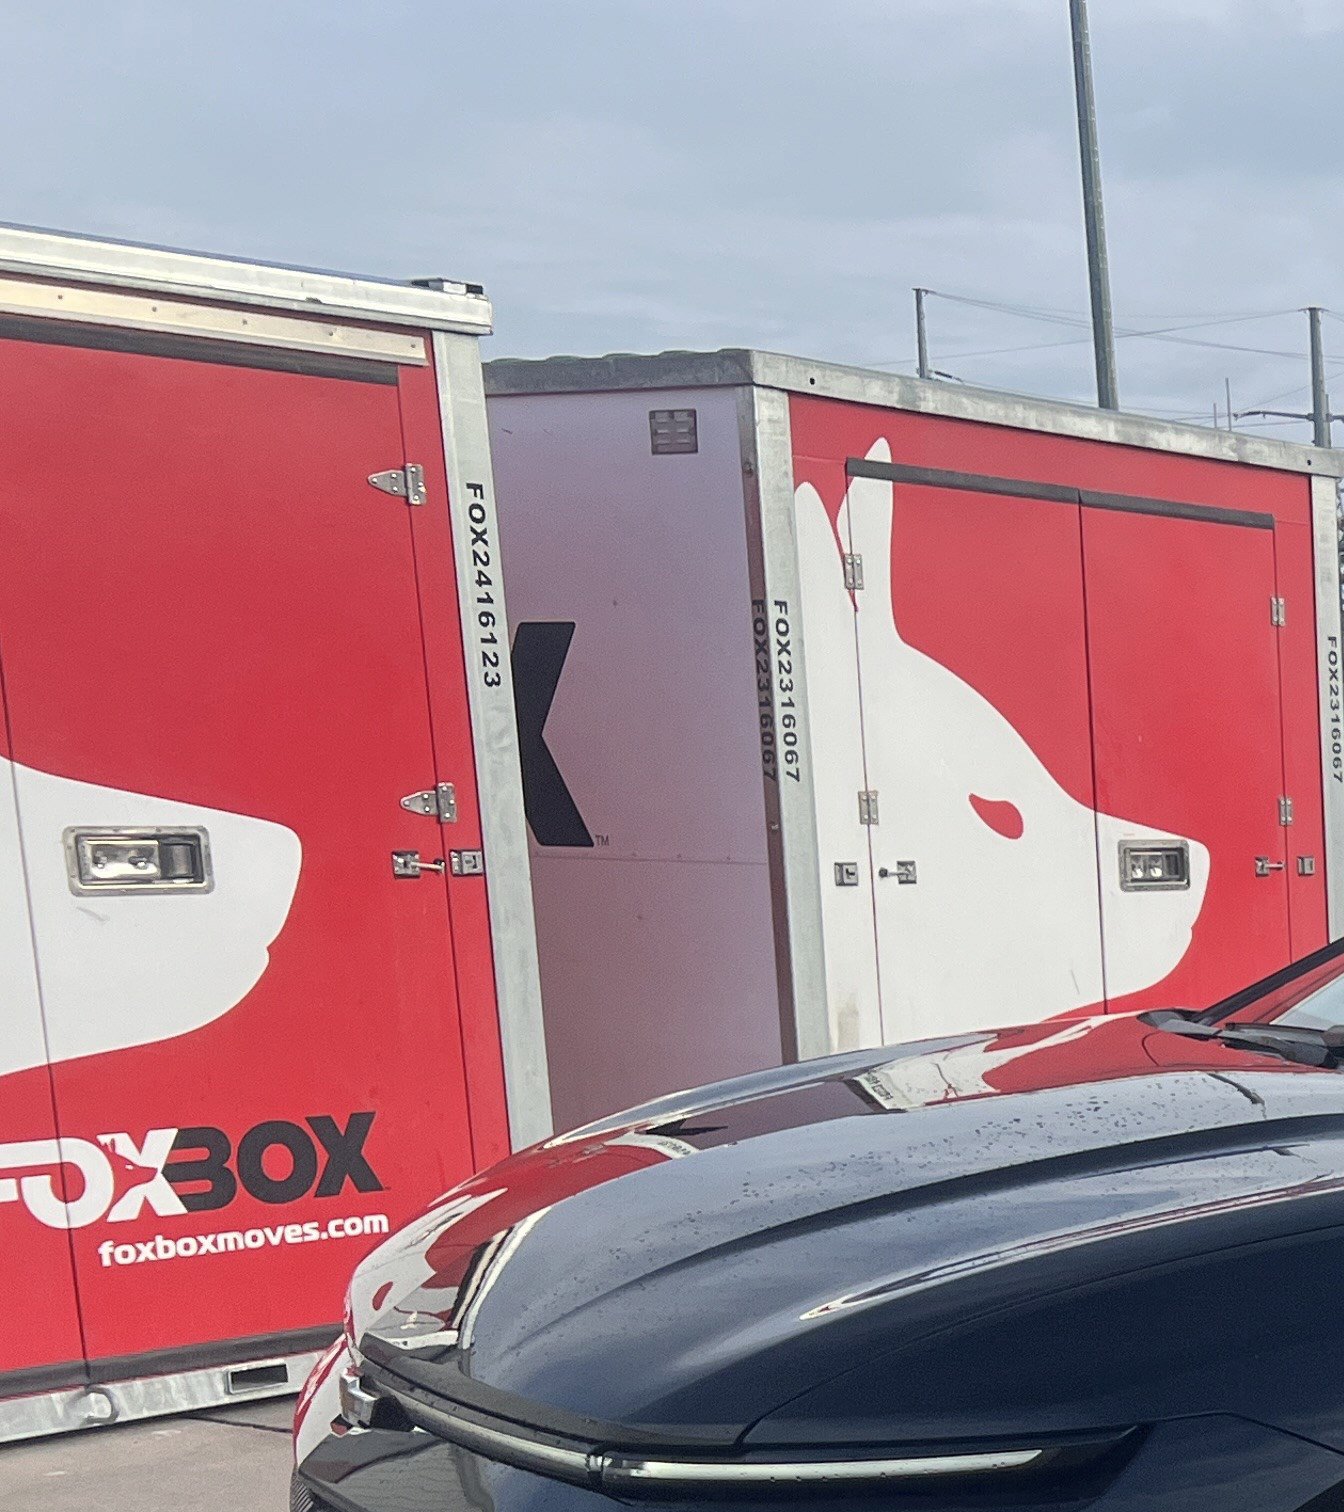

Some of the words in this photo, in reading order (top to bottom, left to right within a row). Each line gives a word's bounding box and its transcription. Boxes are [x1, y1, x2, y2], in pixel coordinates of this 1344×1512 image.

[466, 482, 501, 688] FOX2416123
[752, 600, 777, 782] FOX2316067
[774, 600, 800, 783] FOX2316067
[1327, 636, 1343, 783] FOX2316067
[98, 1213, 390, 1267] foxboxmoves.com
